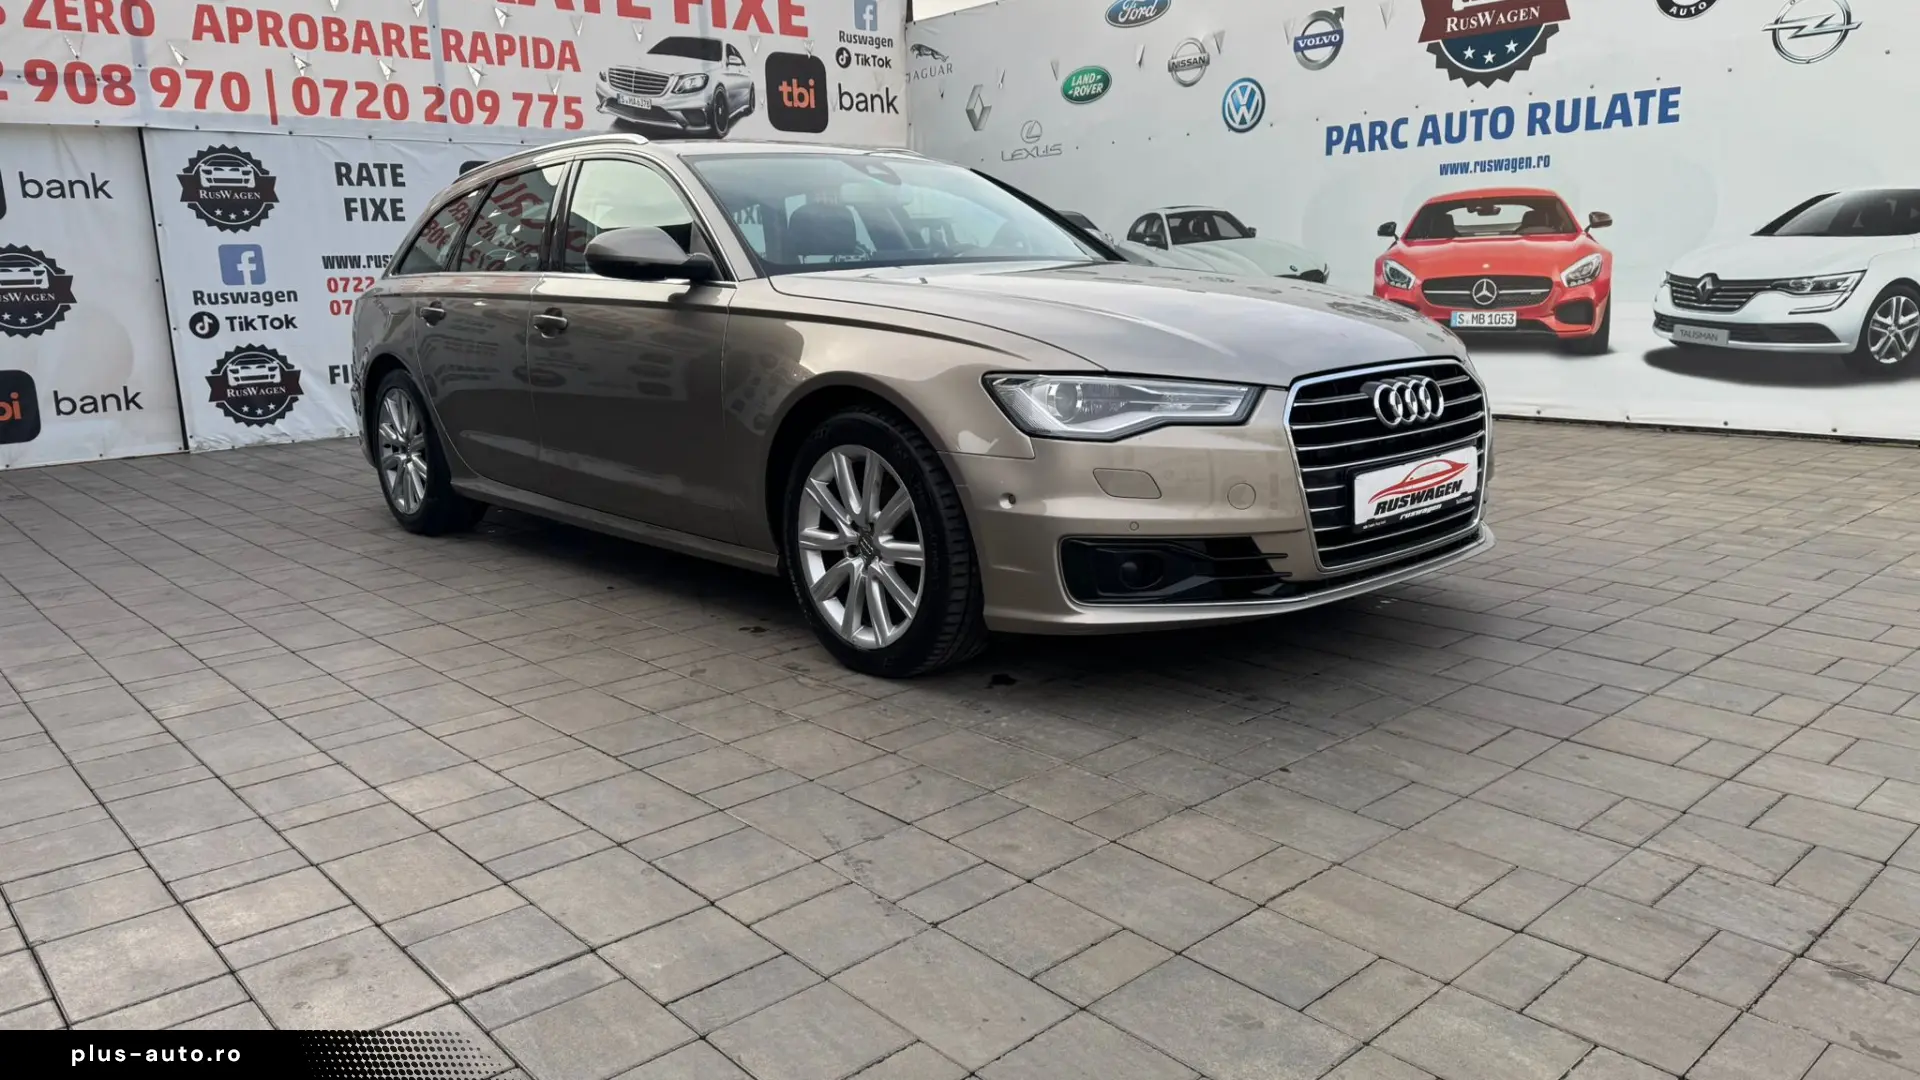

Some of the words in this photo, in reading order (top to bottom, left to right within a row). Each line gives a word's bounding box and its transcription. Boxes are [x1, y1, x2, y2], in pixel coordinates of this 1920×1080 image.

[1669, 1, 1707, 15] AUTO
[23, 0, 155, 36] ZERO
[192, 4, 431, 60] APROBARE
[441, 28, 581, 72] RAPIDA
[838, 30, 894, 49] Ruswagen
[1297, 33, 1340, 48] VOLVO
[854, 53, 892, 69] TikTok
[1171, 55, 1206, 69] NISSAN
[905, 63, 953, 83] JAGUAR
[1071, 73, 1096, 87] LAND
[24, 59, 136, 106] 908
[150, 67, 250, 112] 970
[292, 76, 409, 121] 0720
[423, 86, 500, 125] 209
[512, 92, 584, 130] 775
[779, 78, 816, 109] tbi
[838, 83, 899, 115] bank
[1072, 83, 1104, 98] ROVER
[1325, 117, 1409, 156] PARC
[1416, 105, 1515, 147] AUTO
[1527, 86, 1681, 136] RULATE
[1001, 143, 1062, 161] LEXUS
[1440, 155, 1550, 175] www.ruswagen.ro
[334, 162, 406, 187] RATE
[18, 171, 113, 199] bank
[343, 197, 406, 222] FIXE
[321, 255, 394, 269] www.rus
[327, 276, 375, 293] 0722
[0, 292, 56, 302] SWAGEN
[192, 290, 298, 307] Ruswagen
[330, 300, 353, 316] 07
[225, 314, 298, 332] TikTok
[1488, 313, 1515, 325] 1053
[1680, 329, 1718, 342] TALISMAN
[53, 385, 144, 416] bank
[1374, 479, 1463, 516] RUSWAGEN
